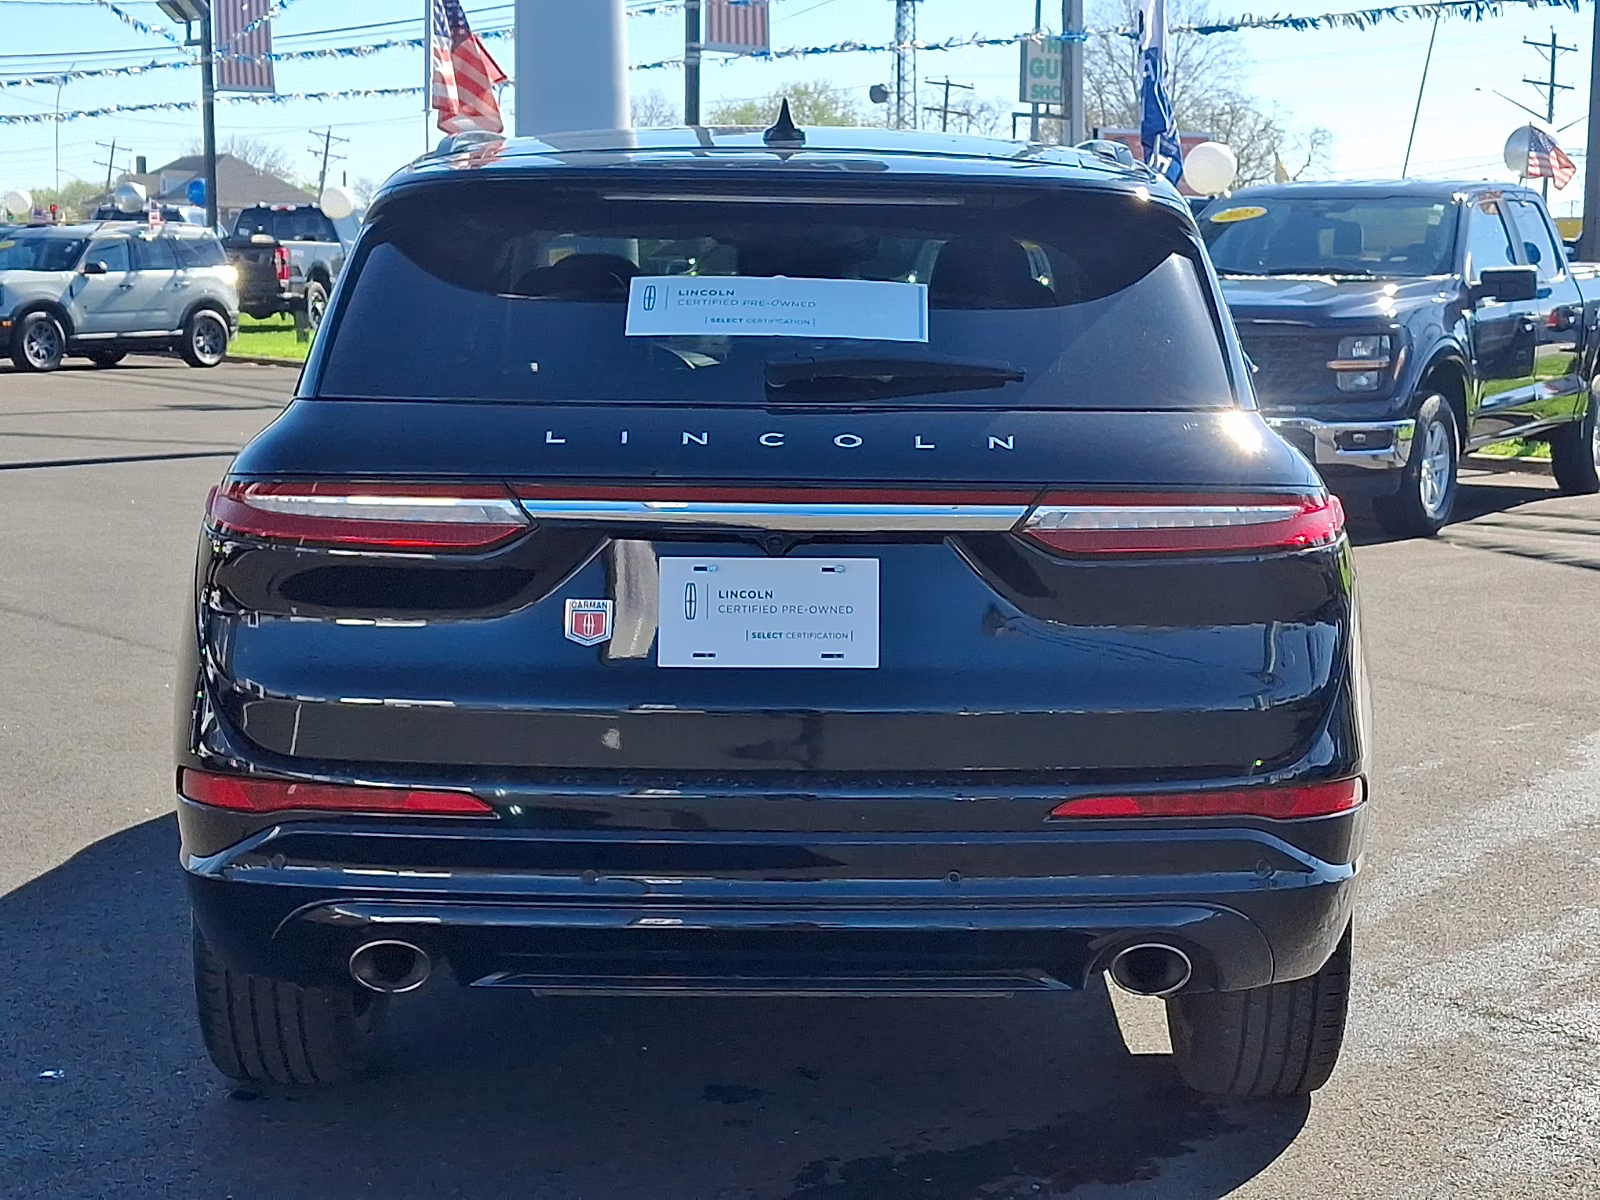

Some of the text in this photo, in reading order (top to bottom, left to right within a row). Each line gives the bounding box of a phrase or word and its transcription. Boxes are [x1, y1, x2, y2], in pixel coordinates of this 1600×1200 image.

[1029, 57, 1064, 80] GU
[678, 289, 735, 297] LINCOLN
[677, 298, 817, 308] CERTIFIED PRE-OWNED
[545, 430, 1014, 450] LINCOLN
[718, 589, 774, 600] LINCOLN
[717, 604, 854, 615] CERTIFIED PRE-OWNED
[751, 631, 849, 640] SELECT CERTIFICATION
